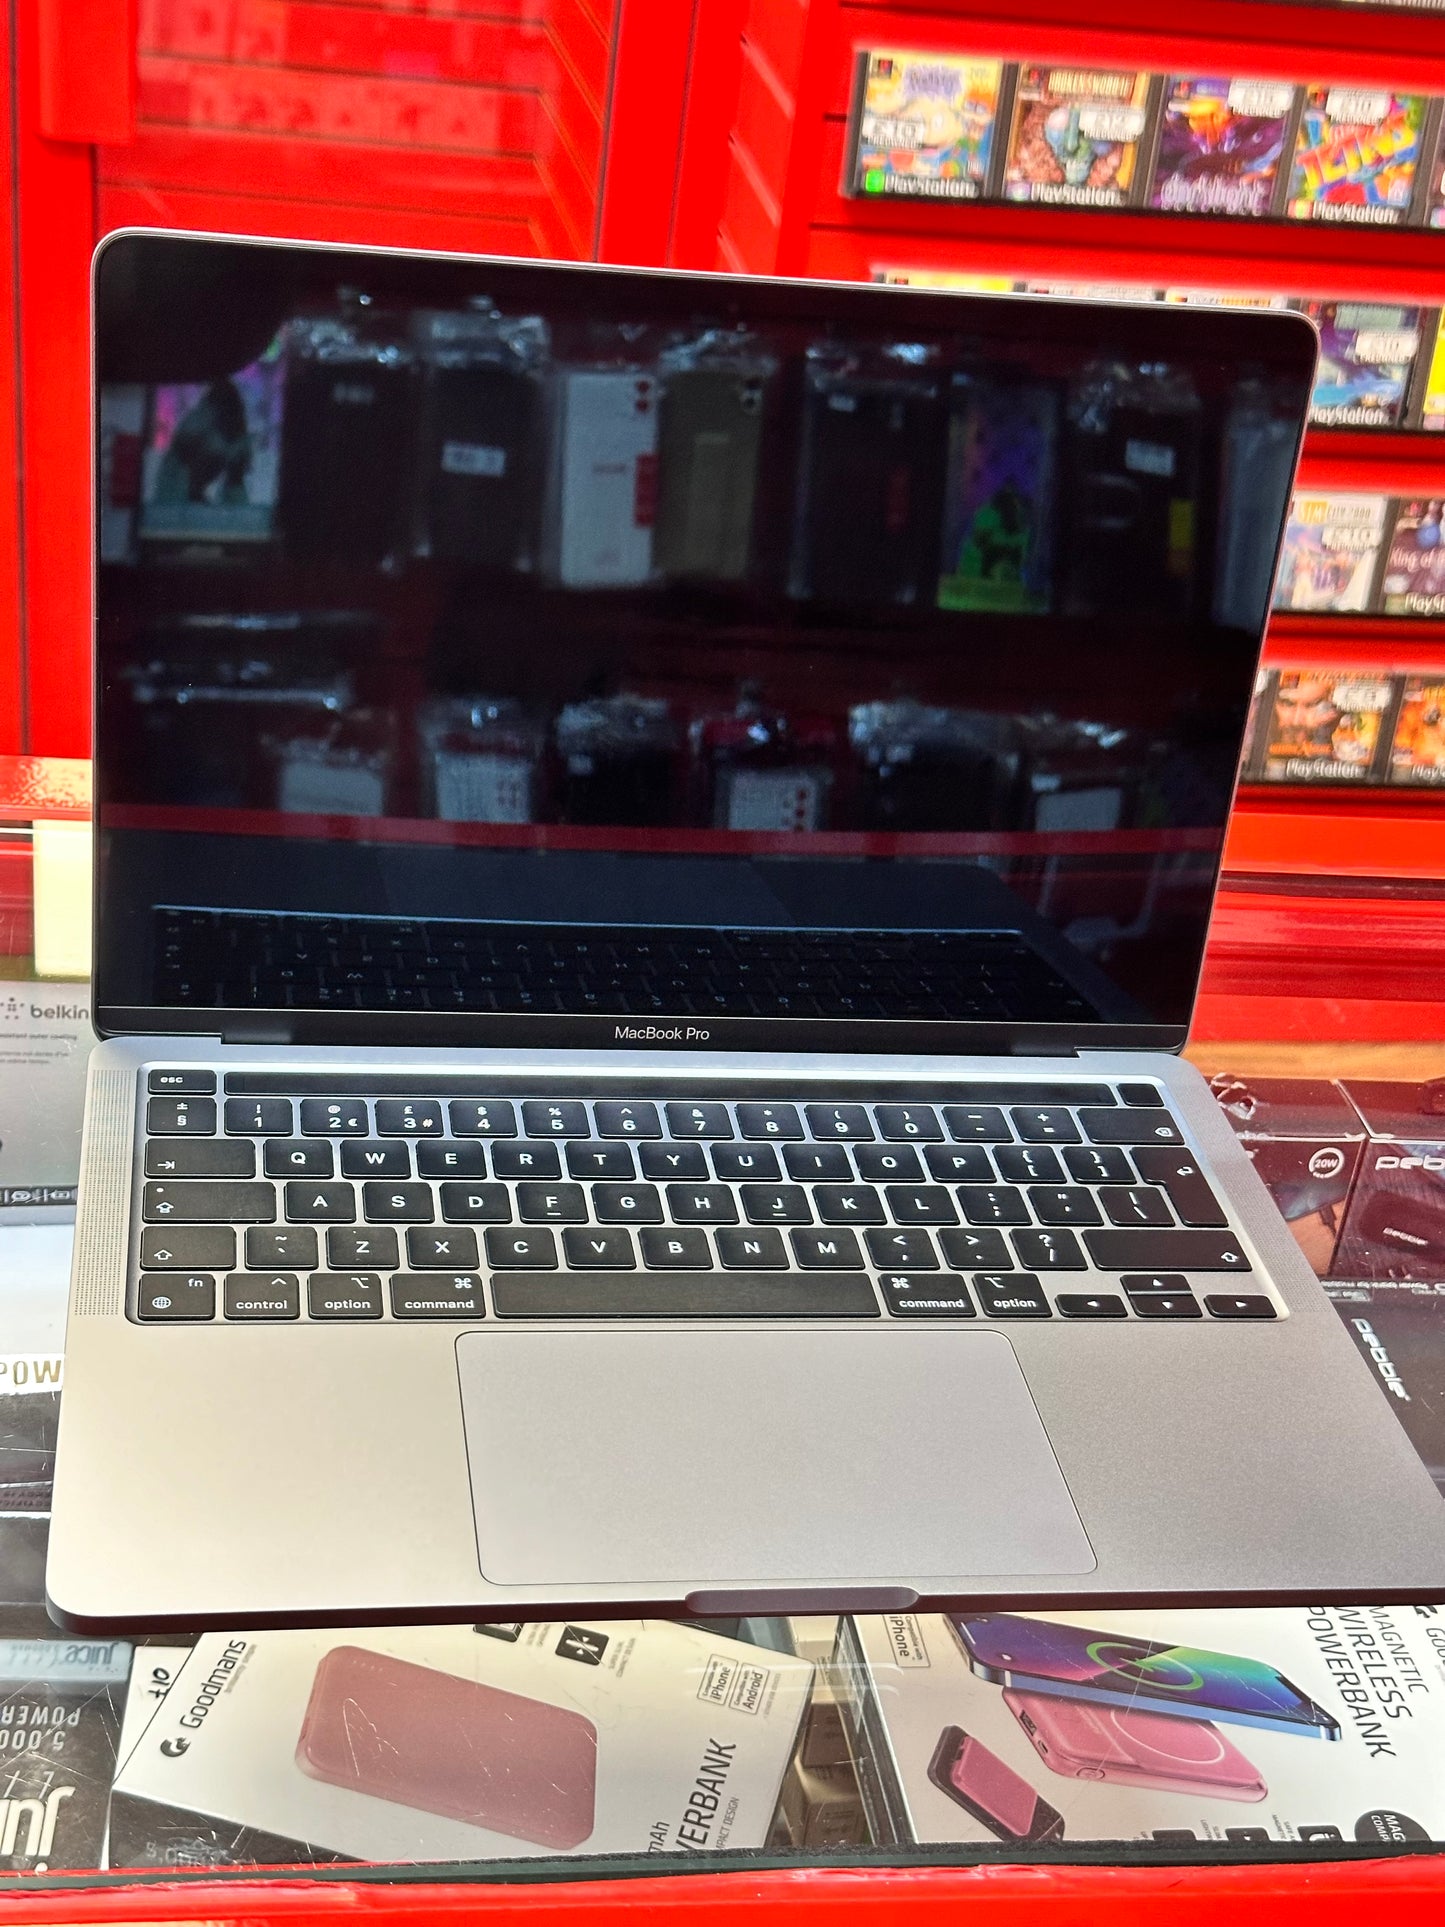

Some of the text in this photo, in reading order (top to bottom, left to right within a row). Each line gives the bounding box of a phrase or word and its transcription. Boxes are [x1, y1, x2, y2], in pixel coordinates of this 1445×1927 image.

[885, 175, 979, 199] PlayStation
[1031, 183, 1122, 206] PlayStation
[1312, 200, 1400, 224] PlayStation
[1286, 758, 1366, 781] PlayStation
[30, 1004, 90, 1020] belkin
[615, 1026, 709, 1039] MacBook Pro
[160, 1076, 184, 1084] esc
[253, 1116, 263, 1128] 1
[328, 1116, 342, 1129] 2
[403, 1117, 417, 1129] 3
[477, 1118, 491, 1130] 4
[551, 1119, 564, 1130] 5
[622, 1119, 637, 1131] 6
[694, 1120, 706, 1132] 7
[765, 1121, 780, 1133] 8
[834, 1121, 849, 1133] 9
[904, 1122, 919, 1134] 0
[290, 1151, 306, 1165] Q
[364, 1152, 386, 1165] W
[444, 1152, 458, 1165] E
[519, 1153, 534, 1165] R
[592, 1153, 607, 1166] T
[666, 1154, 680, 1166] Y
[737, 1155, 754, 1167] U
[814, 1156, 823, 1168] I
[881, 1156, 897, 1168] O
[952, 1156, 967, 1169] P
[1313, 1158, 1338, 1169] 20W
[312, 1195, 329, 1208] A
[391, 1195, 406, 1208] S
[468, 1195, 484, 1208] D
[545, 1196, 558, 1208] F
[620, 1196, 636, 1209] G
[694, 1197, 711, 1209] H
[772, 1197, 784, 1210] J
[841, 1197, 858, 1210] K
[914, 1198, 930, 1210] L
[355, 1240, 370, 1254] Z
[434, 1240, 450, 1254] X
[513, 1240, 529, 1254] C
[590, 1241, 607, 1254] V
[667, 1241, 684, 1254] B
[743, 1241, 761, 1254] N
[817, 1241, 837, 1254] M
[187, 1278, 204, 1287] fn
[235, 1298, 1037, 1311] control option command command option
[889, 1615, 910, 1657] iPhone
[65, 1641, 119, 1671] juice
[1368, 1606, 1430, 1693] MAGNETIC
[180, 1638, 247, 1729] Goodmans
[710, 1665, 731, 1700] iPhone
[742, 1669, 764, 1711] Android
[1, 1704, 81, 1727] POWER
